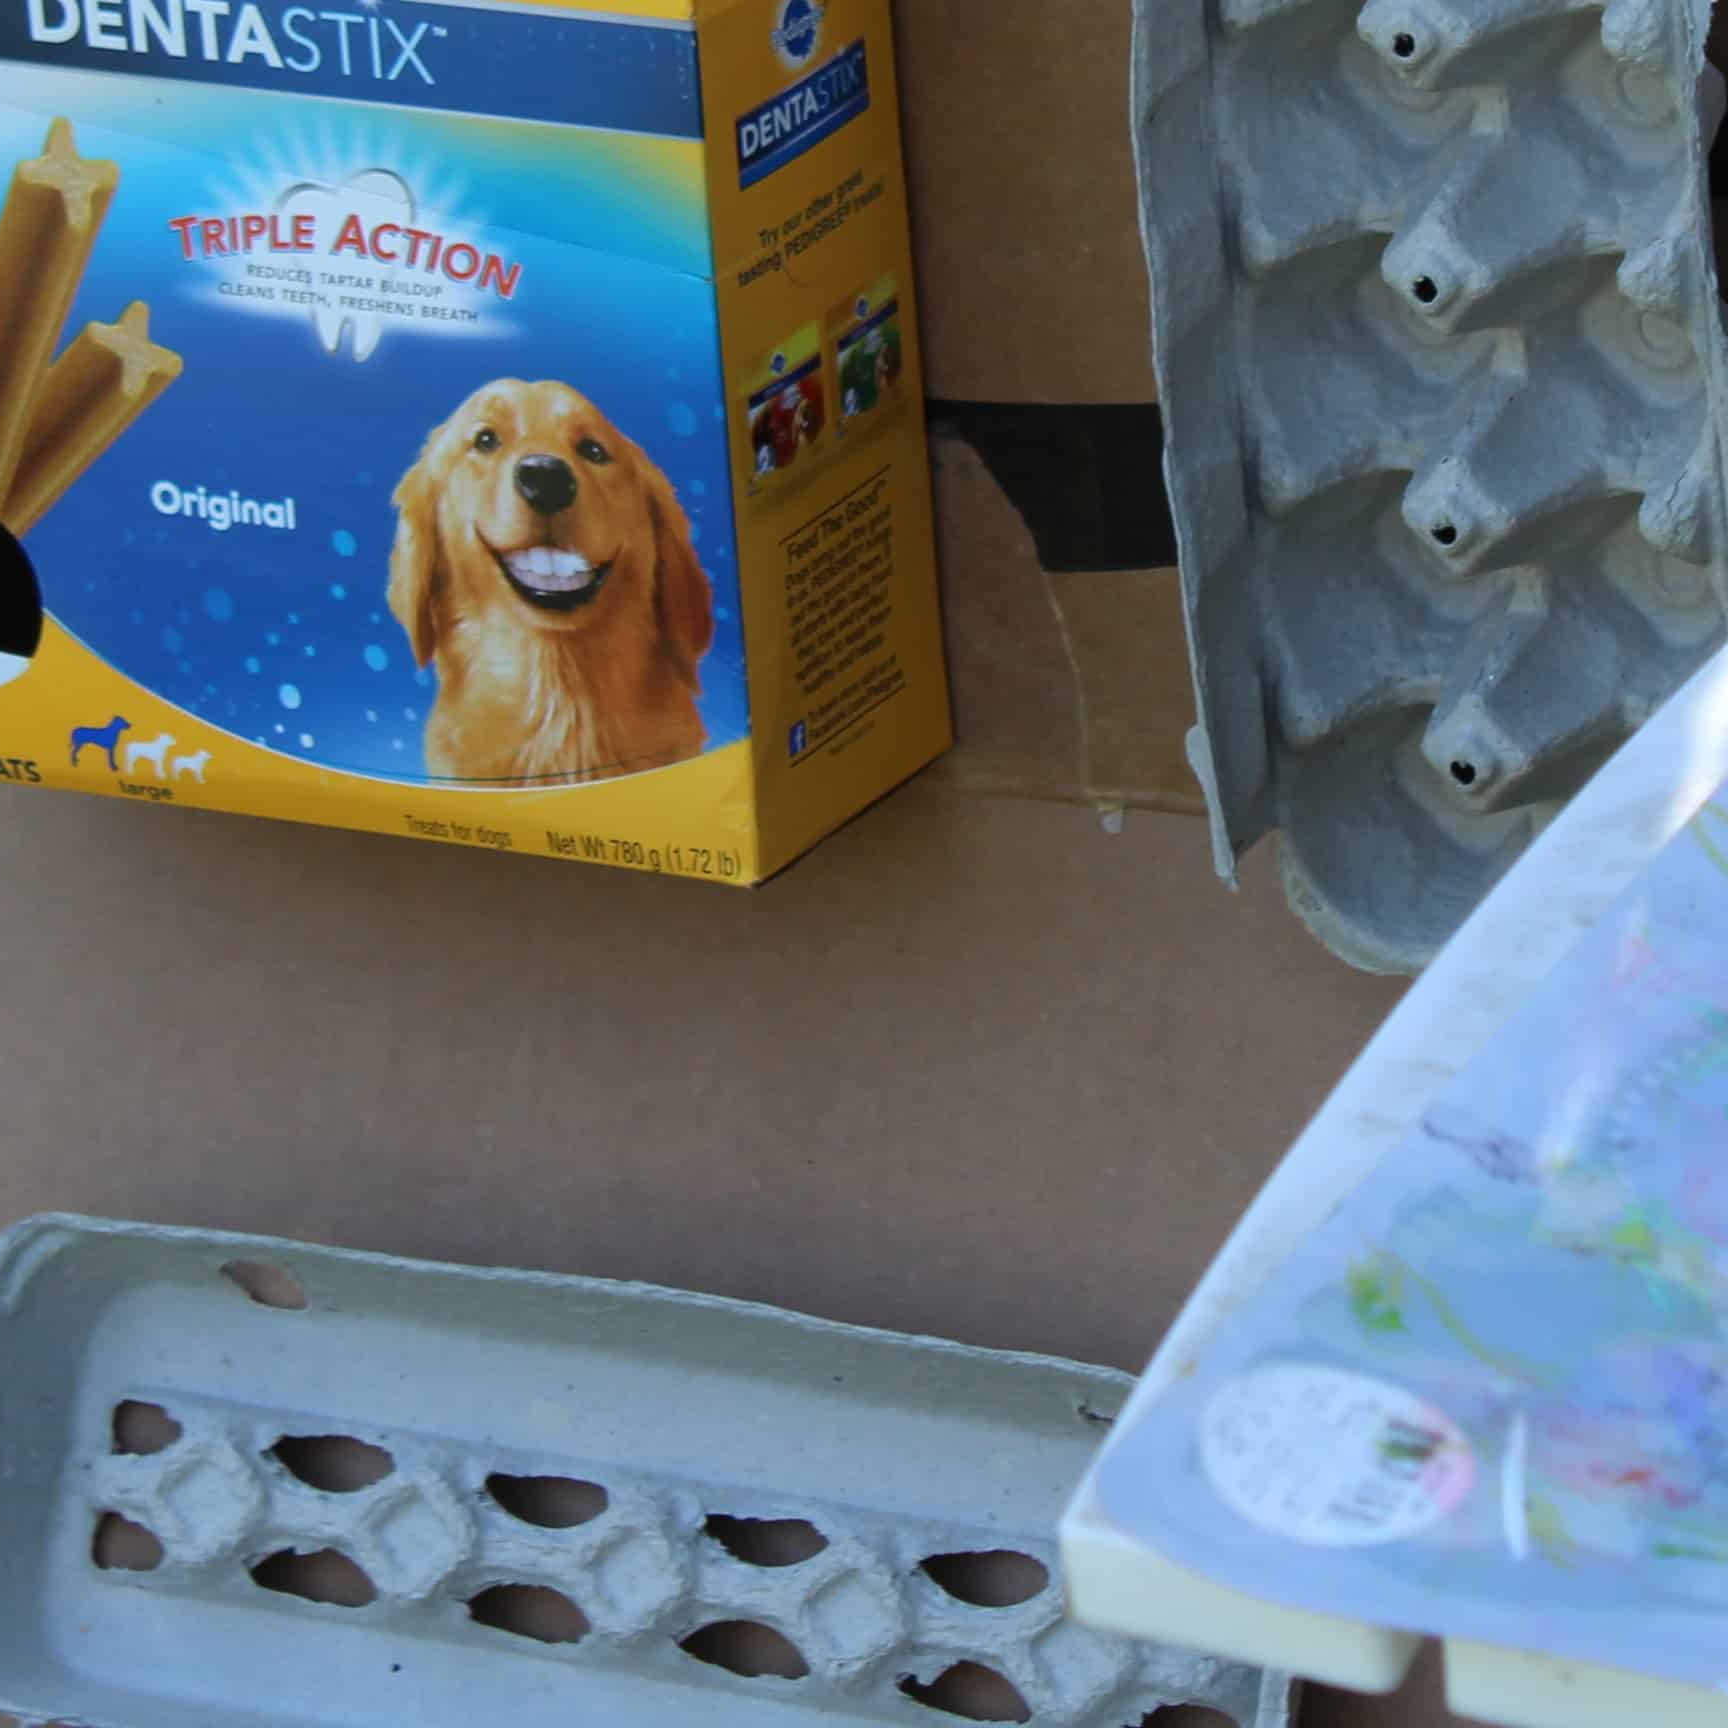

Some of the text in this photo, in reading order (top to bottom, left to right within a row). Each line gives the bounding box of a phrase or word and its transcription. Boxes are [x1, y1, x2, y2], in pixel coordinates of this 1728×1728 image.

[758, 228, 779, 249] Try
[782, 209, 803, 233] our
[168, 214, 523, 299] TRIPLE ACTION
[246, 263, 444, 298] REDUCES TARTAR BUILDUP
[217, 281, 480, 323] CLEANS TEETH, FRESHENS BREATH
[150, 480, 297, 532] Original
[118, 778, 174, 801] large
[403, 813, 449, 839] Treats
[450, 819, 472, 841] for
[545, 829, 742, 878] Net Wt 780 g (1.72 lb)
